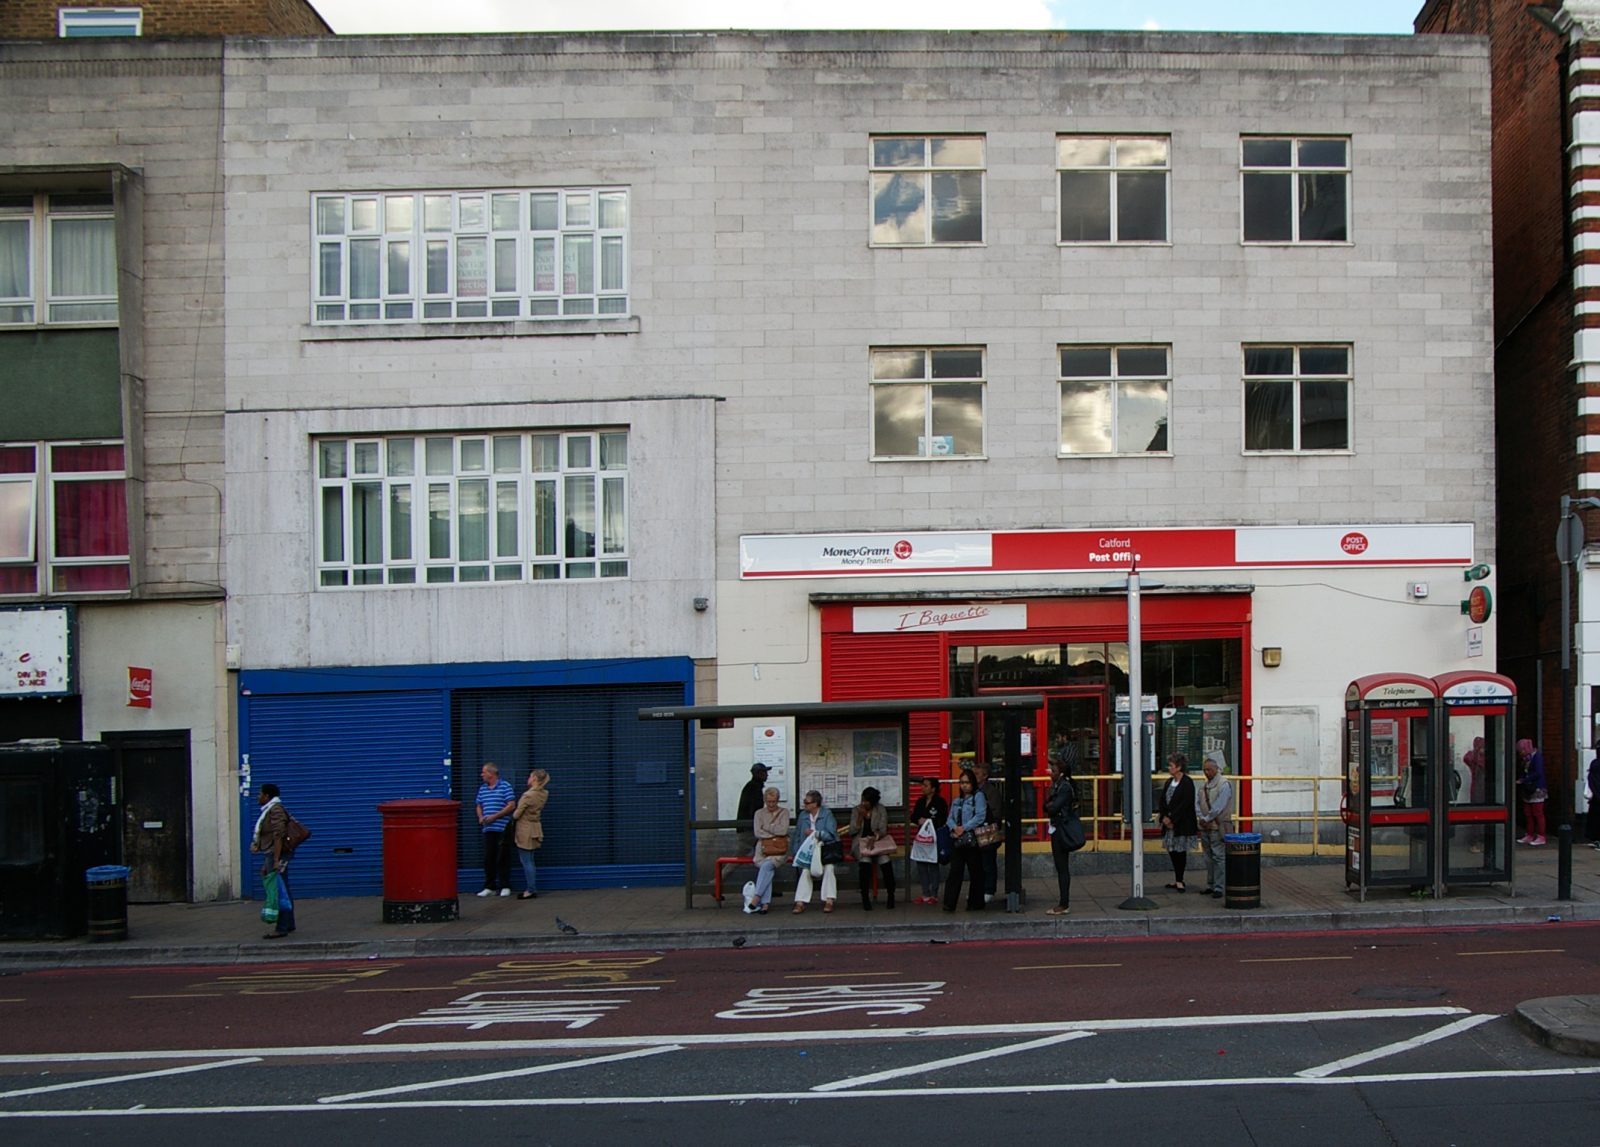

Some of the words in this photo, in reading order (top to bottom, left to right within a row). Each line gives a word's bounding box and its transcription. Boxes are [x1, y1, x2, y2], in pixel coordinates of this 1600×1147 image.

[1099, 538, 1131, 548] Catford
[1343, 543, 1366, 551] OFFICE
[823, 546, 890, 558] MoneyGram
[1089, 552, 1111, 562] Post
[919, 605, 991, 626] Baguette
[18, 679, 46, 687] DNCE
[1383, 687, 1416, 697] Telephone
[1396, 700, 1402, 708] &
[1402, 700, 1419, 708] Cards
[714, 981, 947, 1019] BUS
[362, 986, 661, 1035] LANE
